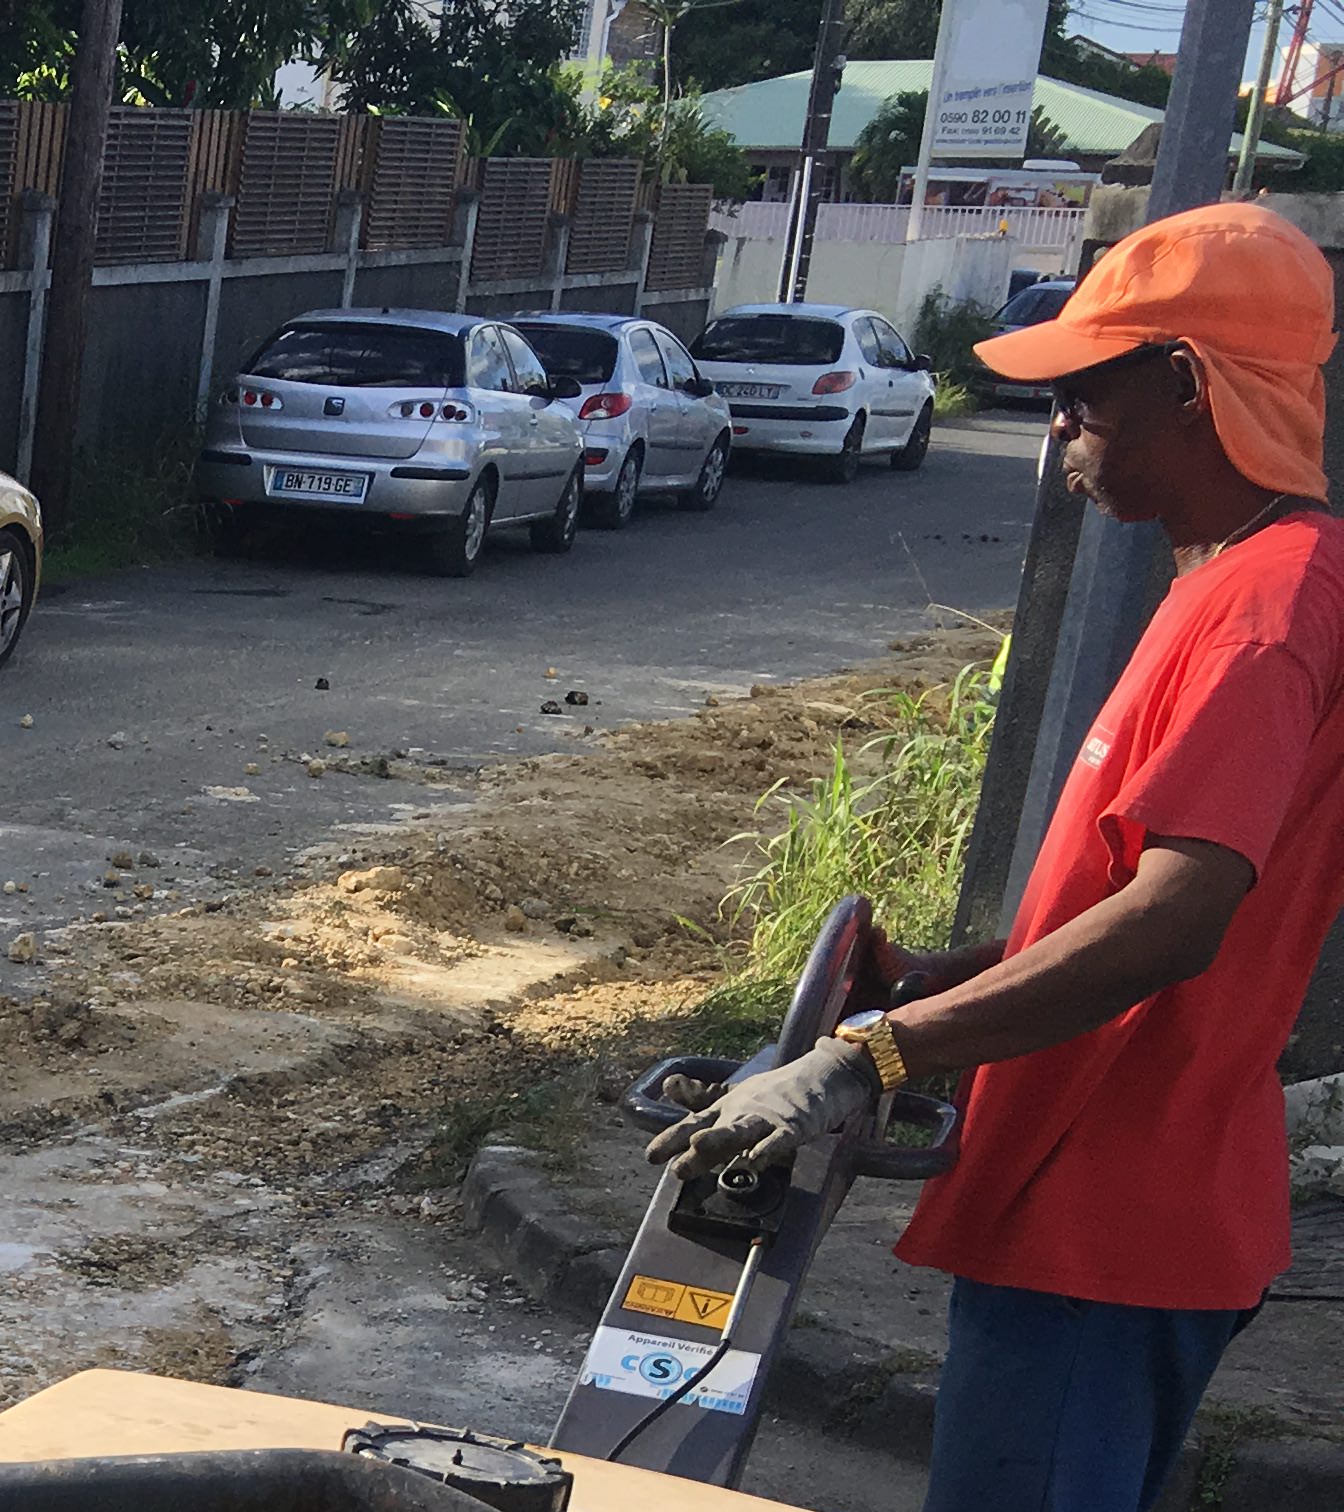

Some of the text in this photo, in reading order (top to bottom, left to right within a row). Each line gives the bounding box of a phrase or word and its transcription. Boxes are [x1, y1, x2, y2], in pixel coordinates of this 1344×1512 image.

[940, 109, 1026, 124] 0590 82 00 11
[628, 1334, 675, 1350] Appareil
